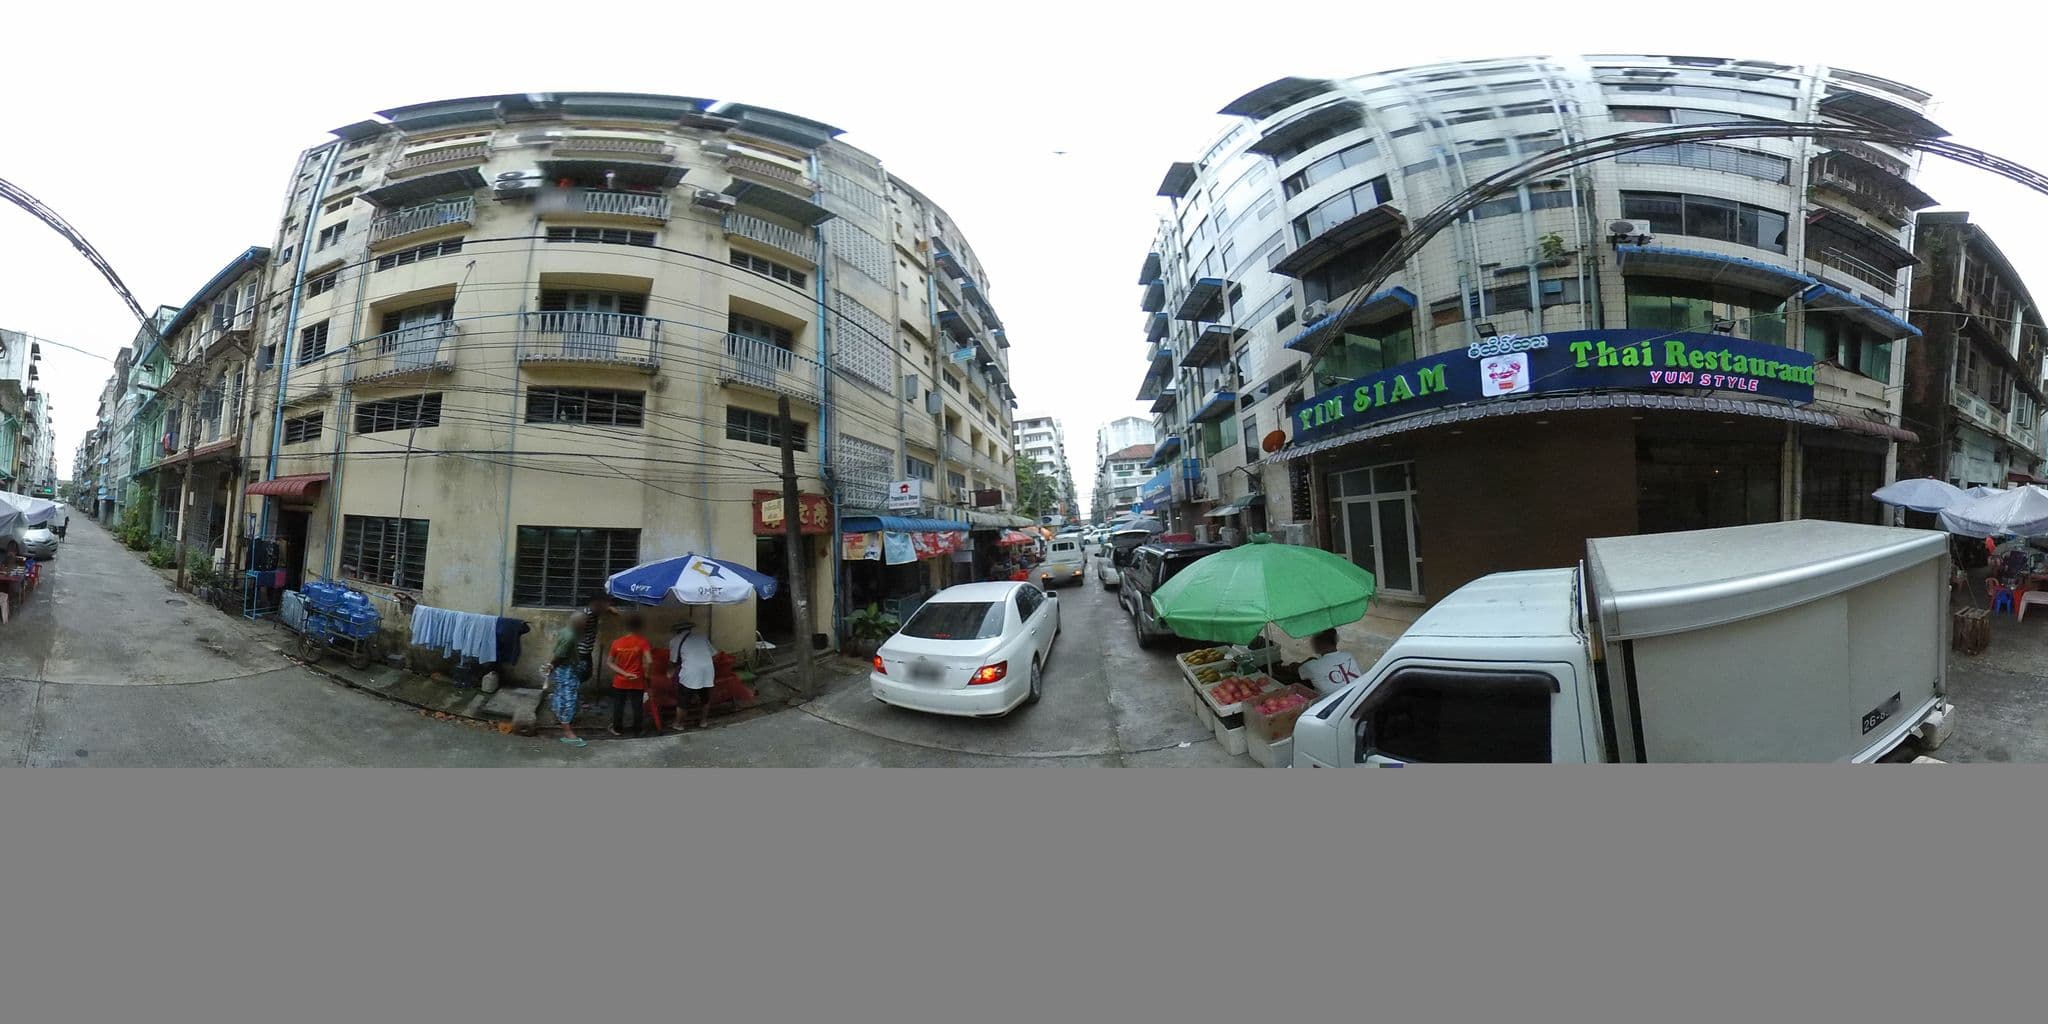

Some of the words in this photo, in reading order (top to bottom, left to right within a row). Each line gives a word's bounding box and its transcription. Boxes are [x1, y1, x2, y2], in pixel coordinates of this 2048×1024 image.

[1569, 340, 1654, 368] Thai
[1664, 340, 1815, 386] Restaurant
[1650, 370, 1694, 385] YUM
[1700, 373, 1760, 392] STYLE
[1298, 395, 1345, 431] YIM
[1353, 363, 1449, 413] SIAM
